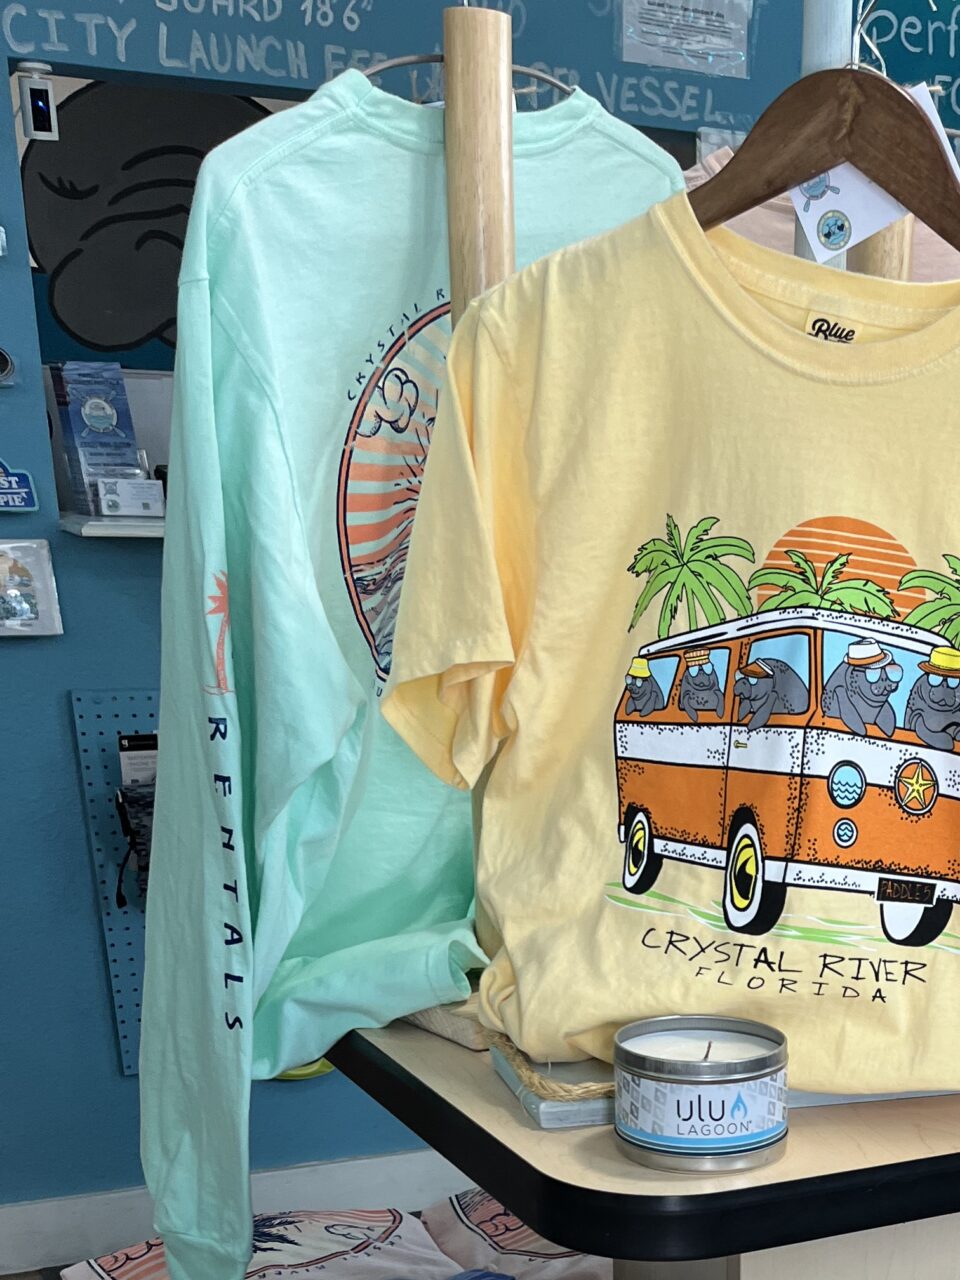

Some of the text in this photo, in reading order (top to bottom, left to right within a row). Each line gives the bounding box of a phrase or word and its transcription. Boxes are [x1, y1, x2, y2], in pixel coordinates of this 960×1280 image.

[2, 5, 137, 62] CITY
[159, 22, 309, 79] LAUNCH
[596, 71, 722, 123] VESSEL
[207, 716, 244, 1031] RENTALS
[881, 880, 932, 903] PADDLES
[641, 927, 928, 986] CRYSTAL RIVER
[695, 966, 887, 1004] FLORIDA
[676, 1094, 726, 1122] ulu
[676, 1122, 750, 1137] LAGOON
